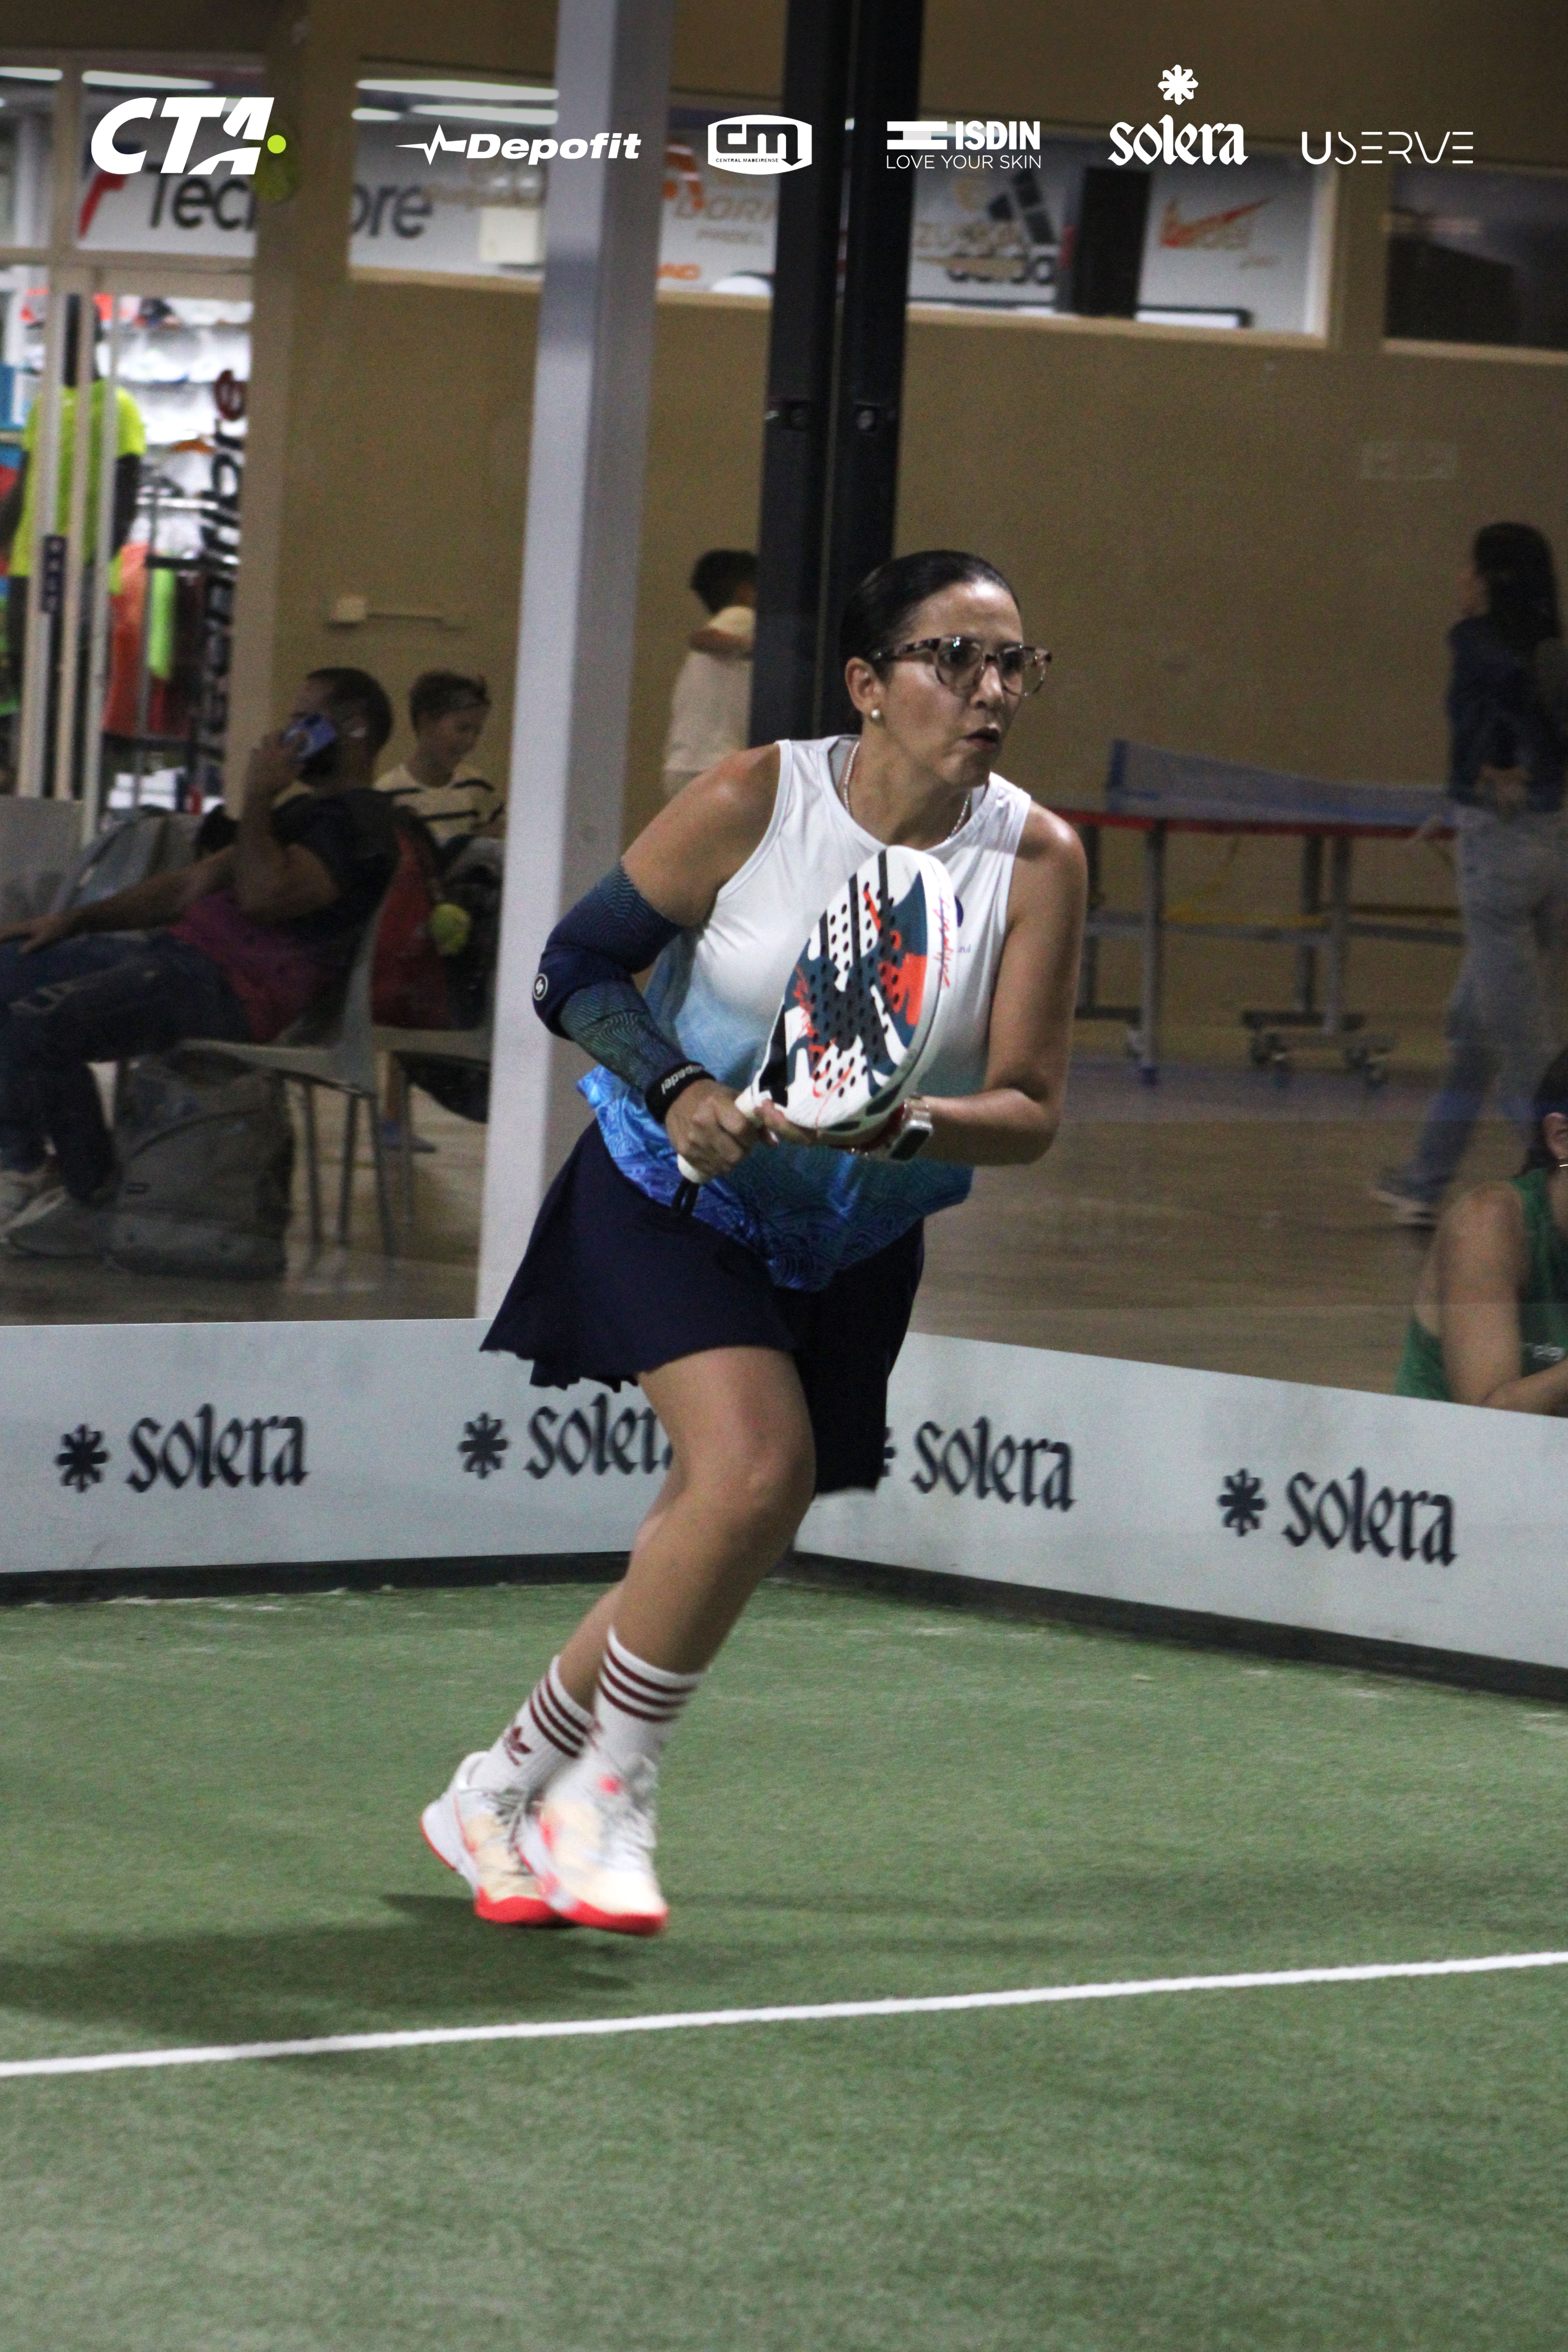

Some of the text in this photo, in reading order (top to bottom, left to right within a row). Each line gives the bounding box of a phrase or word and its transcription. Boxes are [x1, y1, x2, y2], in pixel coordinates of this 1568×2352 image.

[125, 1403, 310, 1493] solera
[524, 1392, 673, 1479] soler
[911, 1415, 1075, 1512] solera
[1282, 1467, 1457, 1566] solera
